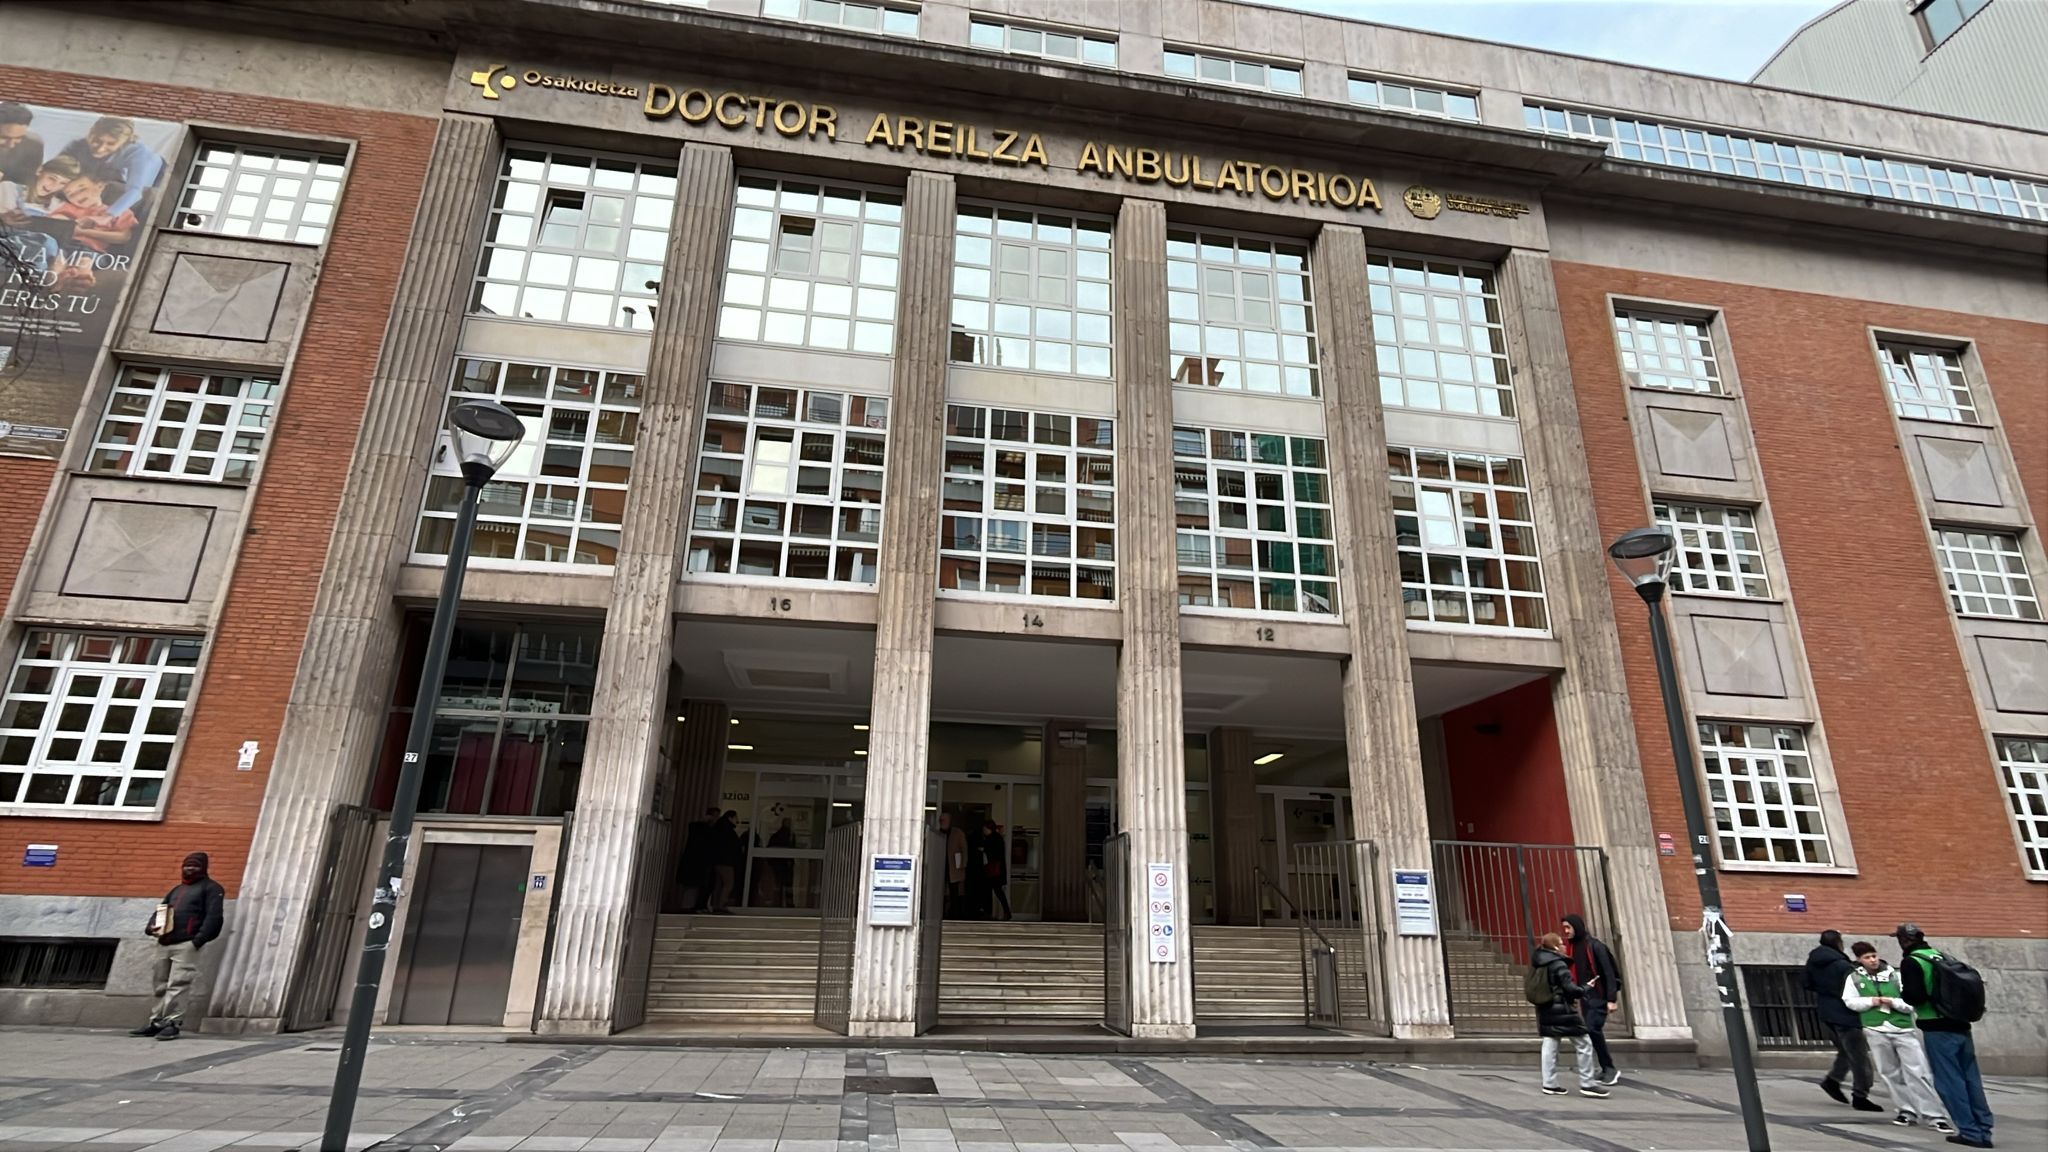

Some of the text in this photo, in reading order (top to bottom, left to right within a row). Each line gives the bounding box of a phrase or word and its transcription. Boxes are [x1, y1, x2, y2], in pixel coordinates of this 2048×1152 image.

[524, 71, 638, 98] Osakidetza
[644, 83, 1382, 213] DOCTOR AREILZA ANBULATORIOA
[18, 245, 131, 271] LA MEJOR
[0, 289, 62, 311] ERES
[770, 597, 792, 612] 16
[1022, 613, 1044, 628] 14
[1256, 627, 1274, 642] 12
[405, 753, 417, 762] 27
